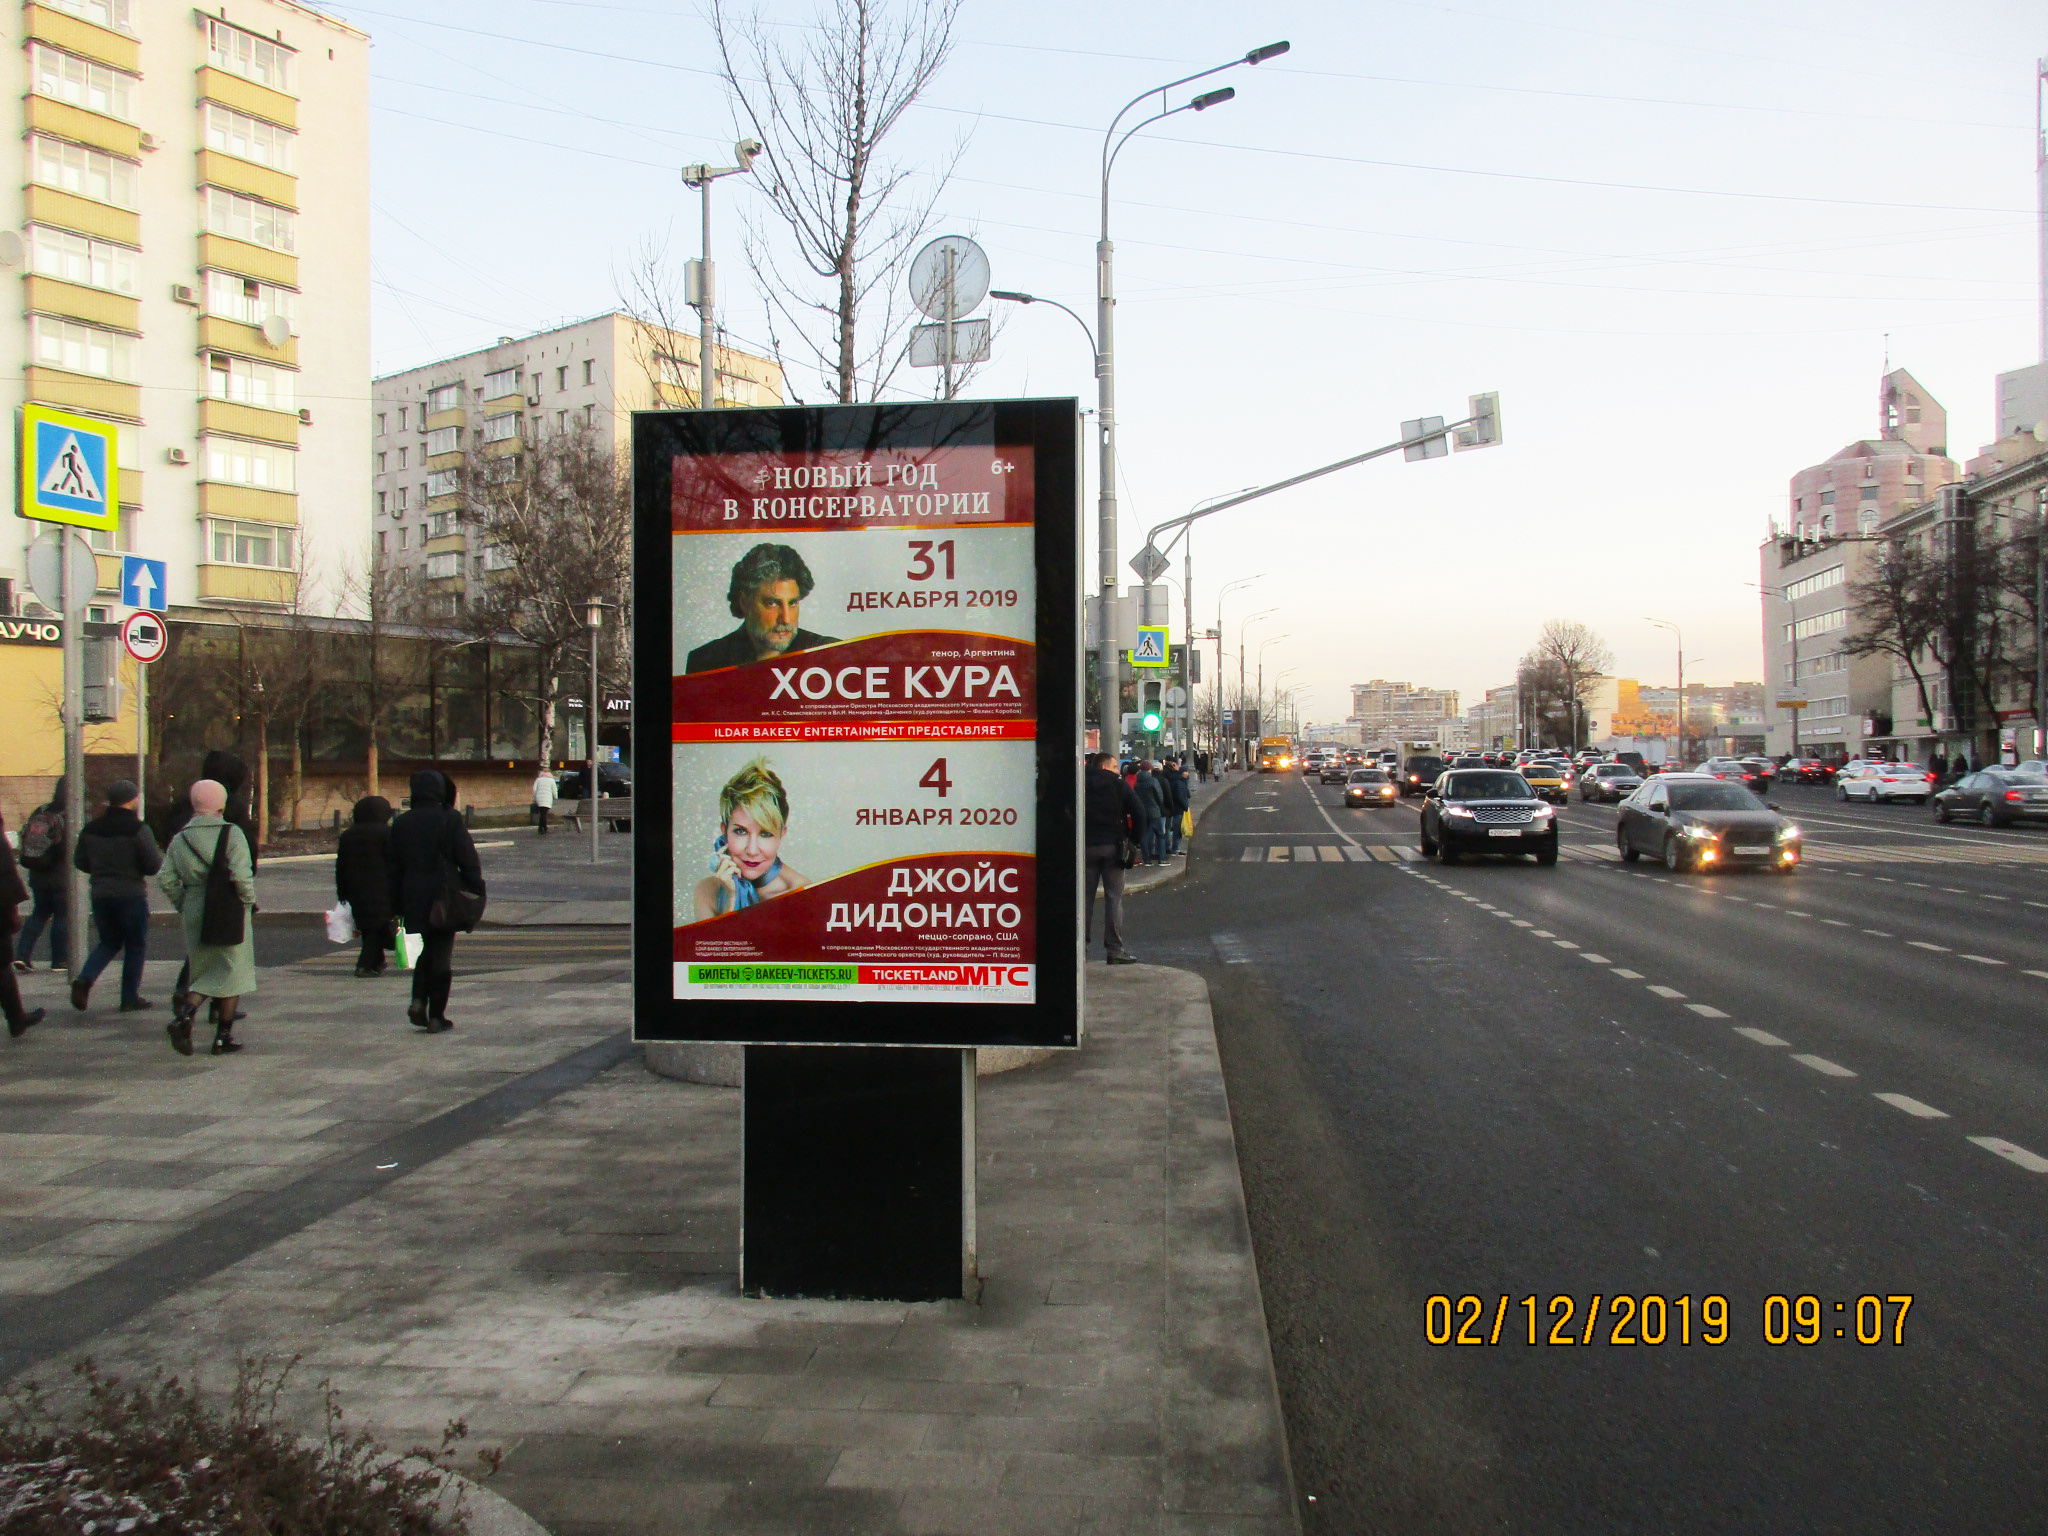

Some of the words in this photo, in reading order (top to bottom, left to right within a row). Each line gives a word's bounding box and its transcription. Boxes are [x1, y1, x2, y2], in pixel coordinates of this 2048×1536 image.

[774, 461, 873, 489] НОВЫЙ
[886, 463, 938, 490] ГОД
[990, 460, 1015, 475] 6+
[723, 498, 739, 521] В
[752, 491, 991, 520] КОНСЕРВАТОРИИ
[906, 540, 956, 581] 31
[847, 590, 959, 612] ДЕКАБРЯ
[966, 589, 1018, 608] 2019
[930, 649, 961, 660] тенор,
[964, 647, 1015, 659] Аргентина
[769, 666, 890, 701] ХОСЕ
[905, 664, 1022, 699] КУРА
[714, 728, 748, 738] ILDAR
[753, 727, 801, 738] BAKEEV
[804, 727, 905, 737] ENTERTAINMENT
[907, 726, 1005, 737] ПРЕДСТАВЛЯЕТ
[919, 757, 953, 798] 4
[855, 808, 953, 826] ЯНВАРЯ
[959, 808, 1018, 826] 2020
[887, 861, 1019, 897] ДЖОЙС
[826, 903, 1022, 932] ДИДОНАТО
[918, 933, 994, 941] меццо-сопрано,
[996, 932, 1019, 940] США
[699, 968, 740, 980] БИЛЕТЫ
[755, 968, 852, 980] BAKEEV-TICKETS.RU
[872, 969, 959, 981] TICKETLAND
